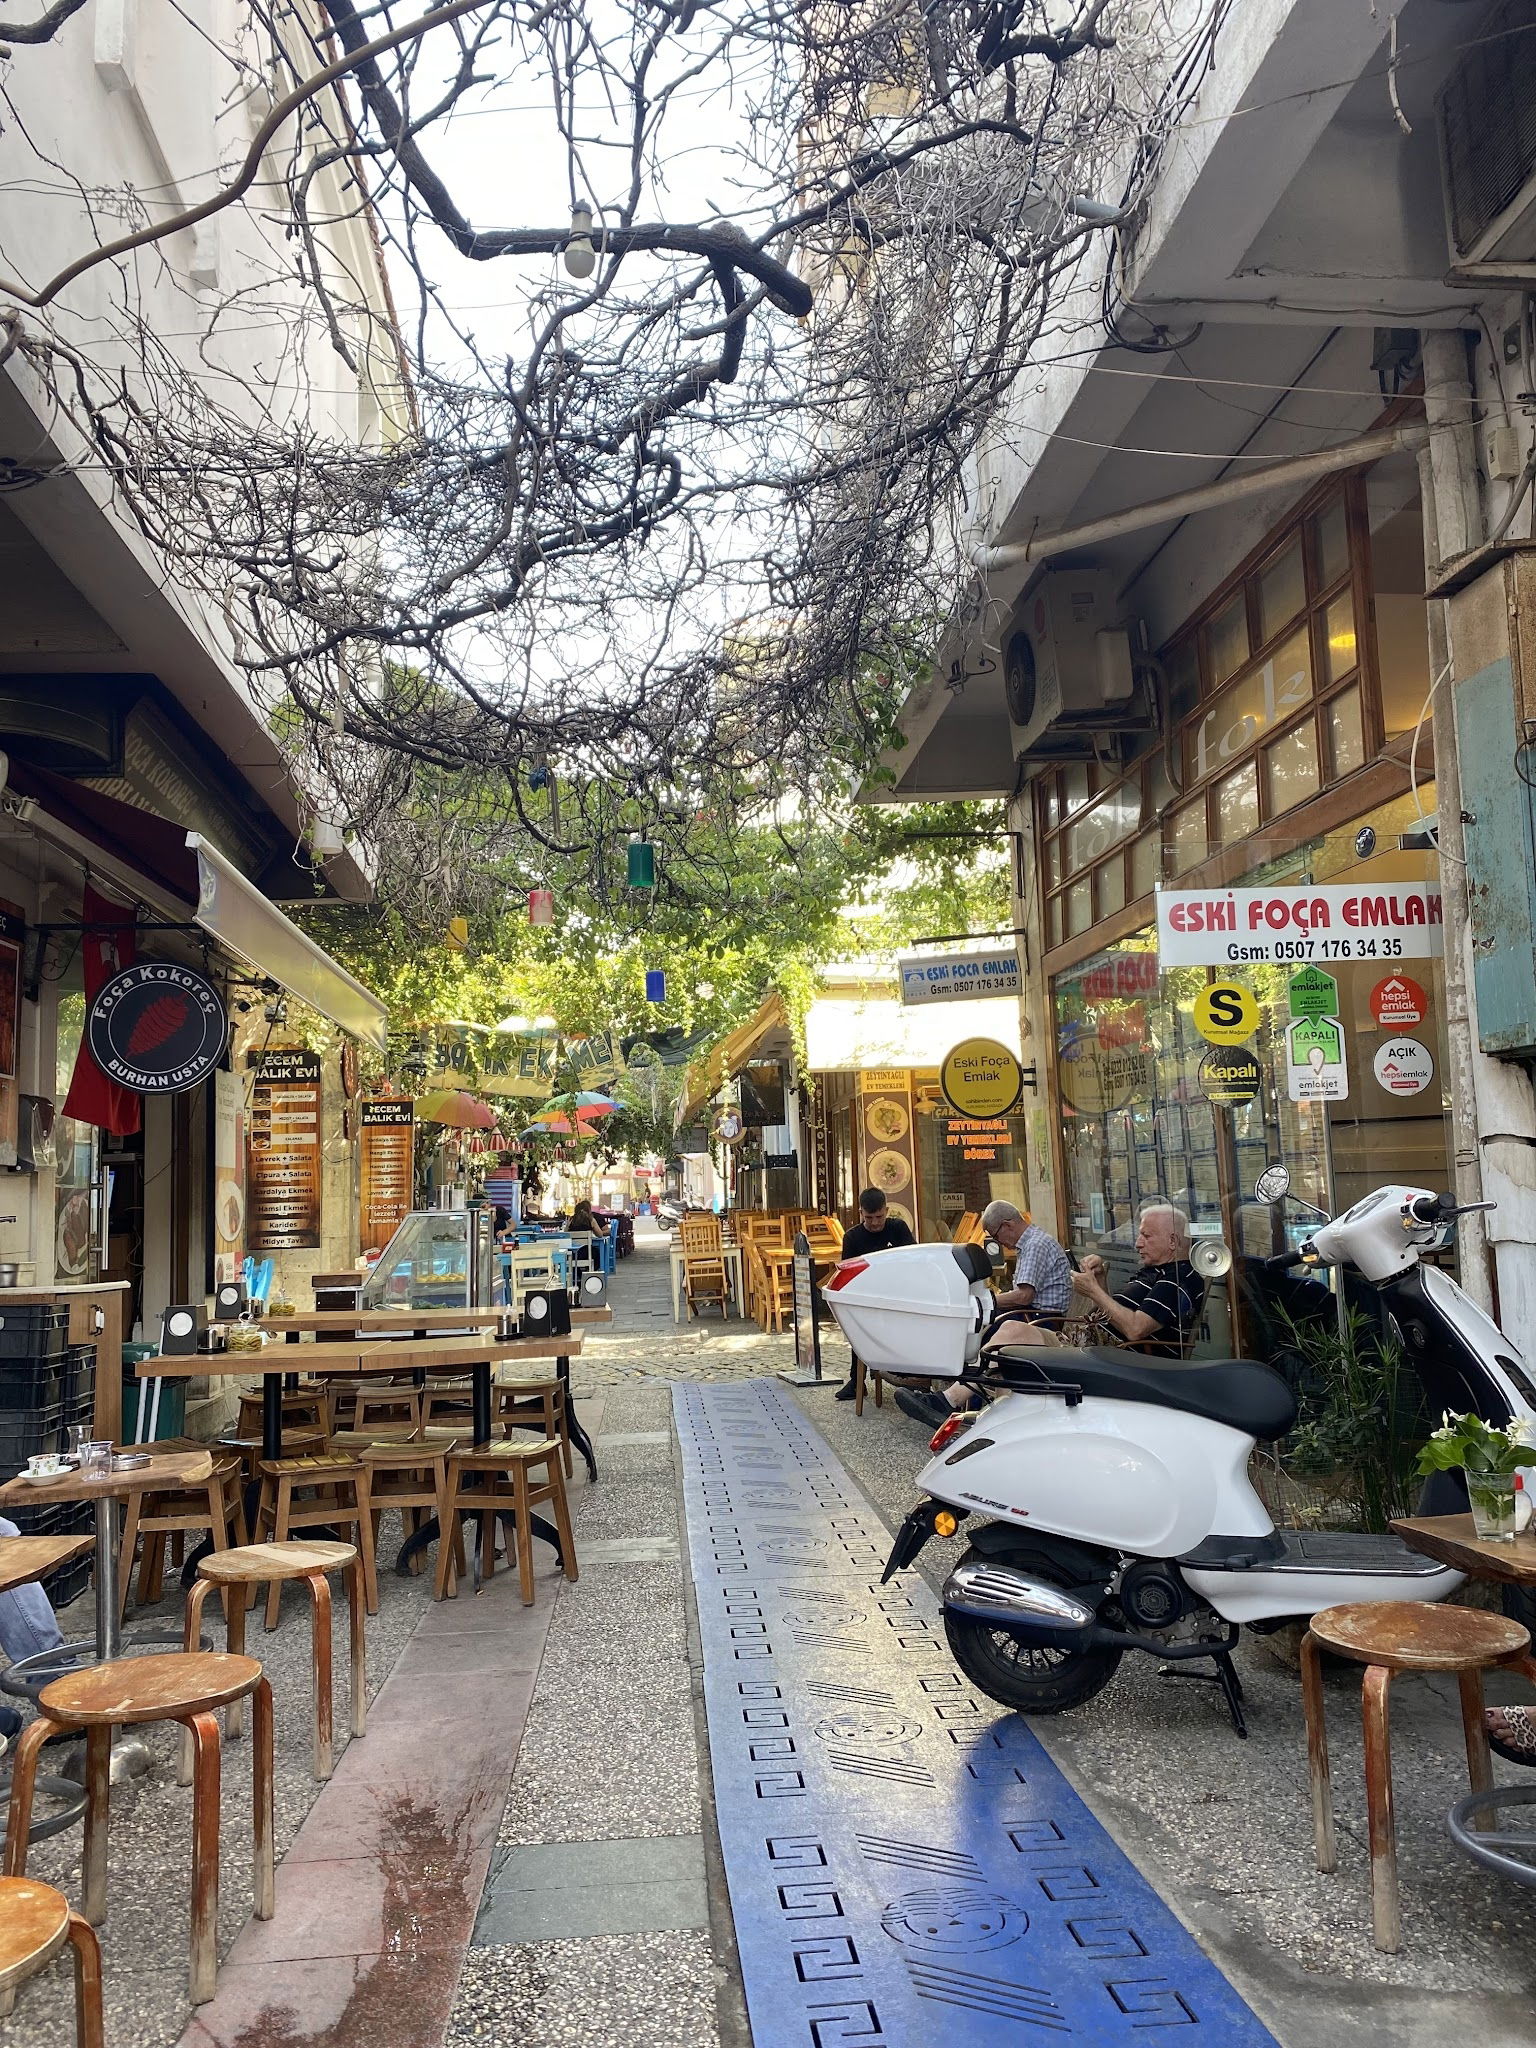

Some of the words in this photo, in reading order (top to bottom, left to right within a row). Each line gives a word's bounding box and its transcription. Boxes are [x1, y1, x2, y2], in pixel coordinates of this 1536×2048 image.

[1168, 892, 1236, 932] ESKİ
[1249, 898, 1331, 938] FOÇA
[1342, 894, 1442, 927] EMLAK
[1227, 943, 1269, 961] Gsm:
[1275, 941, 1315, 959] 0507
[1321, 940, 1351, 957] 176
[1357, 939, 1377, 956] 34
[1382, 938, 1402, 955] 35
[982, 959, 1018, 975] EMLAK
[930, 984, 952, 995] Gsm:
[954, 980, 974, 992] 0507
[978, 979, 992, 990] 176
[994, 978, 1005, 988] 34
[1006, 976, 1017, 987] 35
[1291, 982, 1334, 992] emlakjet
[94, 976, 134, 1019] Foça
[140, 966, 216, 1014] Kokoreç
[1381, 990, 1410, 1002] hepsi
[1209, 989, 1243, 1026] S
[1382, 1001, 1415, 1011] emlak
[1295, 1030, 1335, 1041] KAPALI
[1388, 1047, 1417, 1059] AÇIK
[265, 1055, 303, 1066] ECEM
[953, 1057, 978, 1068] Eski
[981, 1056, 1010, 1068] Foça
[108, 1059, 169, 1086] BURHAN
[172, 1055, 209, 1082] USTA
[296, 1066, 317, 1078] EVİ
[963, 1071, 1000, 1082] Emlak
[1204, 1063, 1257, 1081] Kapalı
[1381, 1070, 1428, 1079] hepsiemlak
[1299, 1080, 1338, 1089] emlakjet
[374, 1105, 401, 1113] ECEM
[364, 1114, 393, 1122] BALIK
[395, 1112, 411, 1121] EVİ
